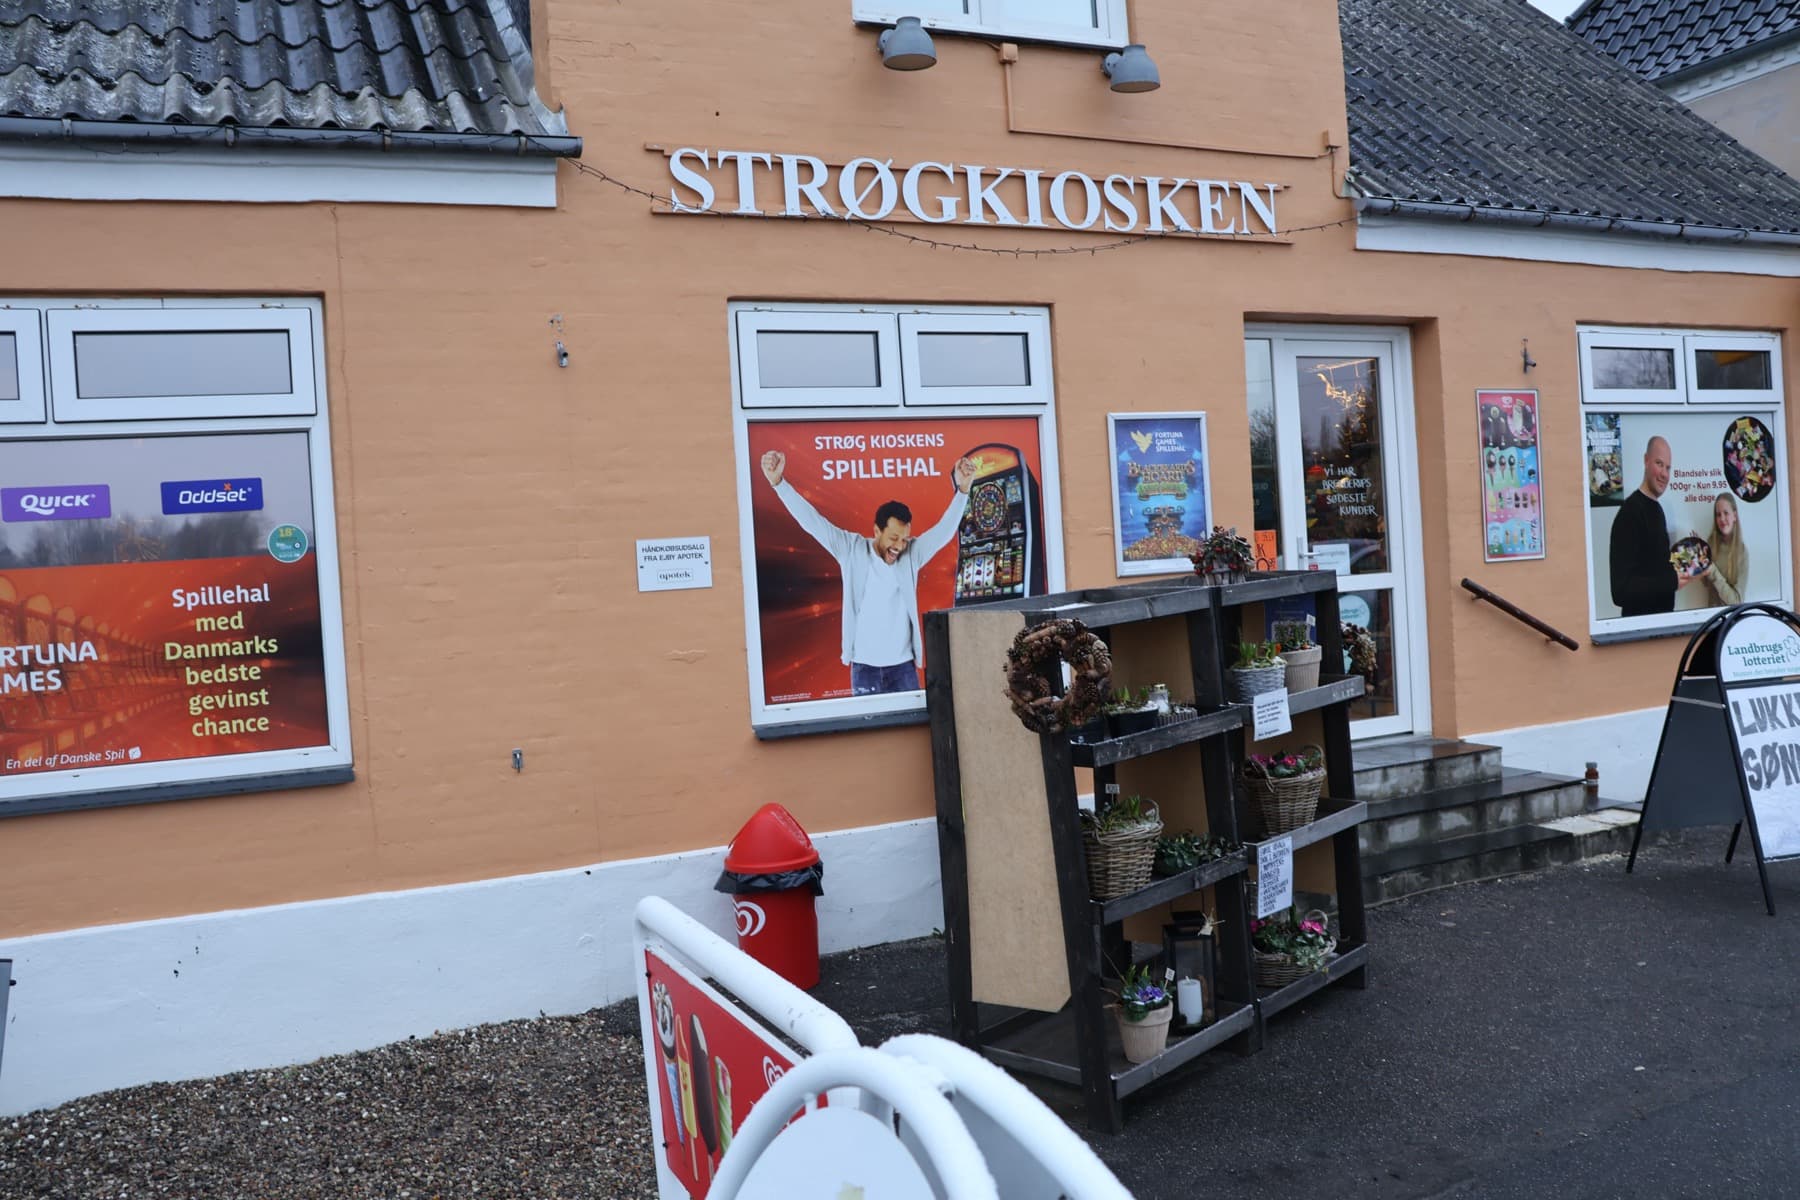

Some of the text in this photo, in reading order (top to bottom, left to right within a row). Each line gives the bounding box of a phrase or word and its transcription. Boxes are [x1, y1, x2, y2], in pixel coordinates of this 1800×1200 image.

[668, 147, 1279, 238] STRØGKIOSKEN
[815, 433, 945, 452] STRØG KIOSKENS
[822, 457, 942, 480] SPILLEHAL
[1337, 466, 1357, 477] HAR
[1669, 481, 1691, 491] 100gr
[1697, 480, 1711, 489] Kun
[1711, 480, 1728, 489] 9.95
[20, 494, 90, 516] QUICK
[178, 487, 248, 505] Oddset
[1684, 494, 1698, 502] alle
[1339, 505, 1378, 517] KUNDER
[677, 552, 704, 560] APOTEK
[659, 570, 691, 581] apotek
[171, 583, 271, 611] Spillehal
[195, 610, 245, 632] med
[164, 635, 279, 661] Danmarks
[1727, 642, 1784, 655] Landbrugs
[1742, 654, 1787, 667] lotteriet
[185, 663, 262, 686] bedste
[189, 688, 270, 716] gevinst
[192, 716, 271, 737] chance
[6, 749, 125, 769] En del af Danske Spil
